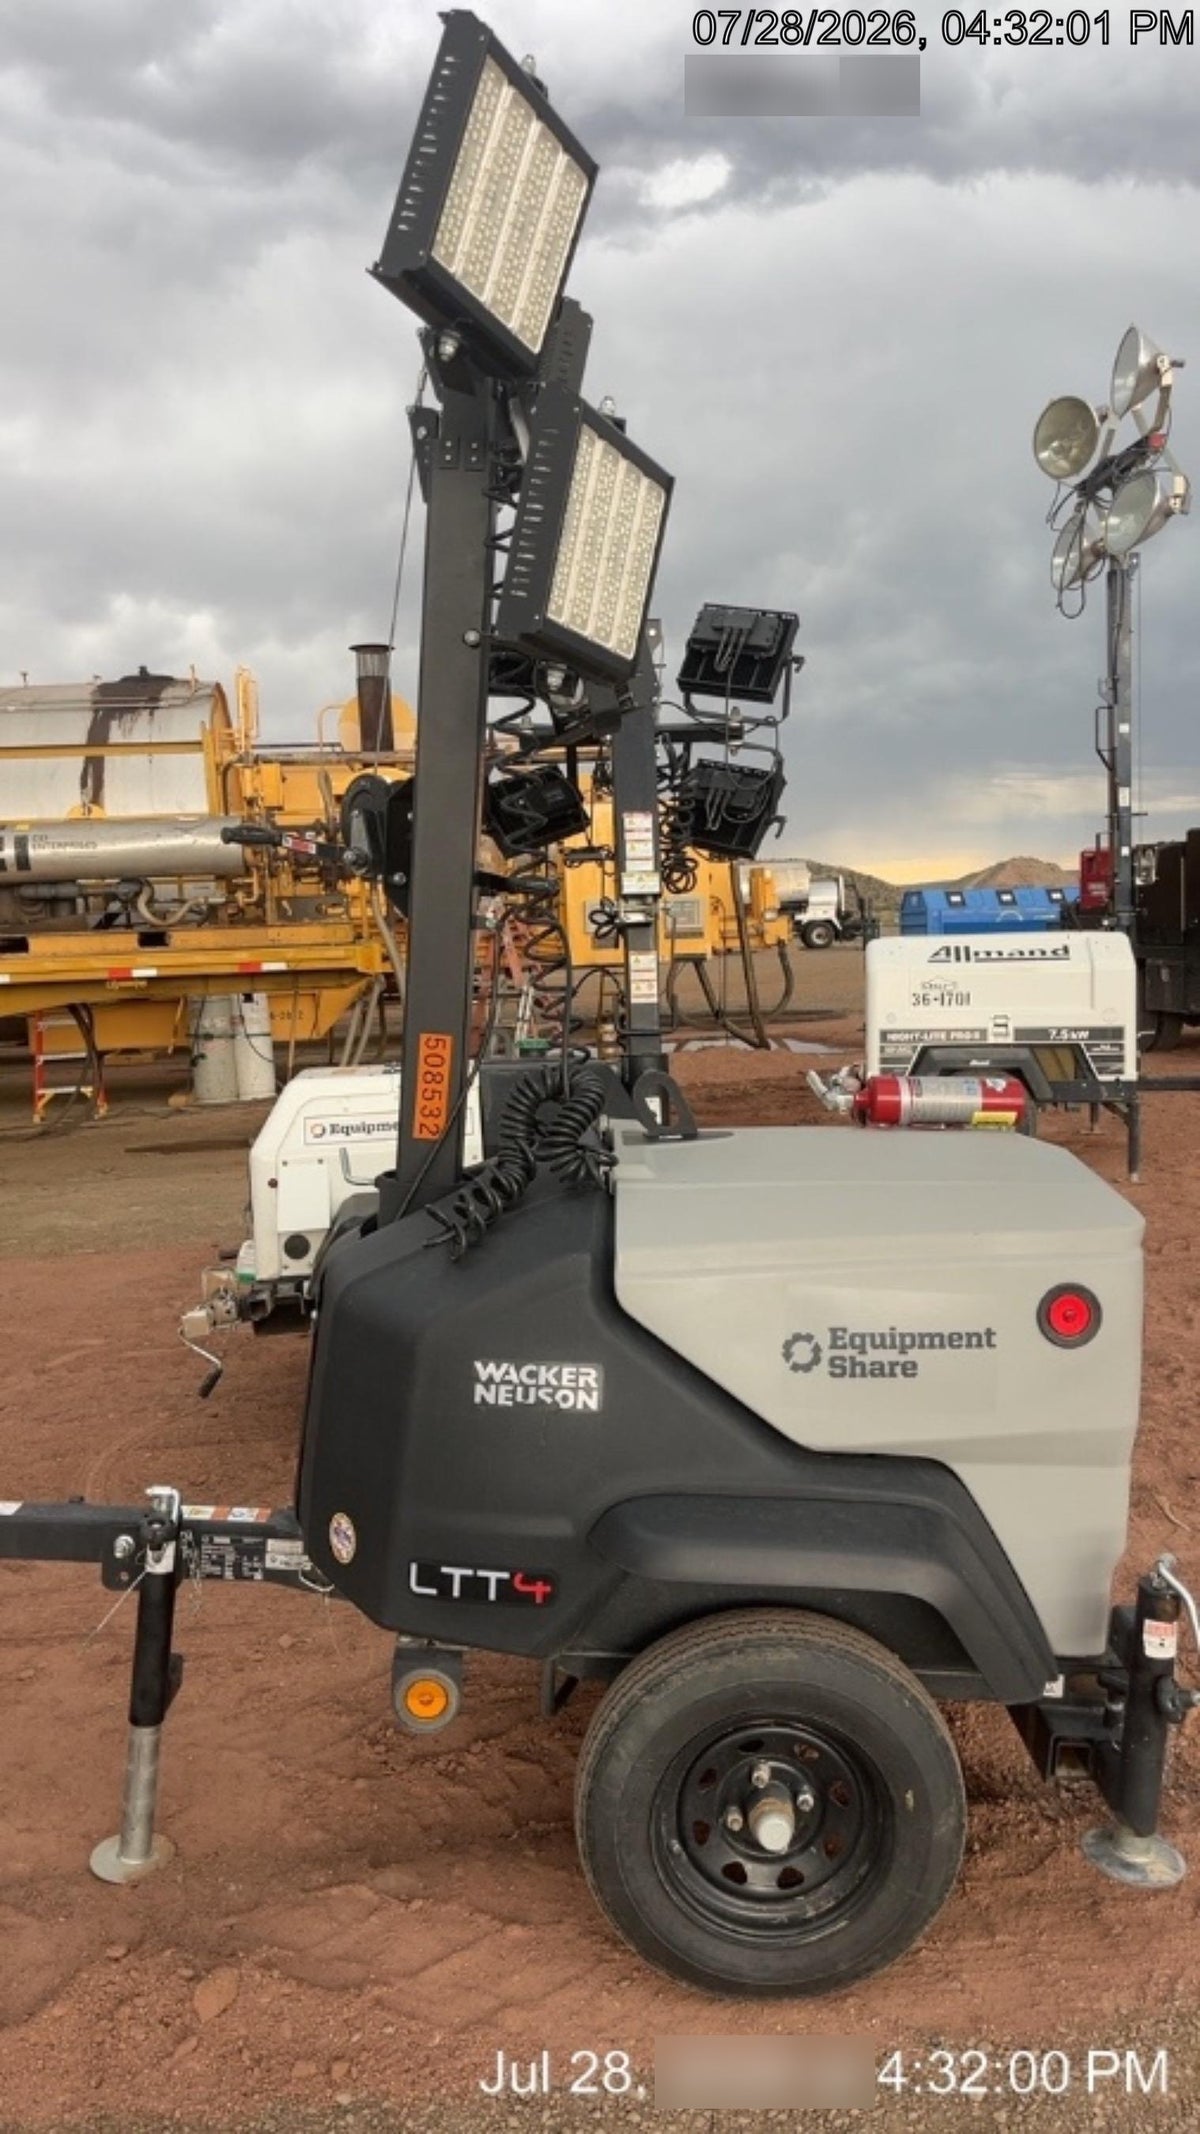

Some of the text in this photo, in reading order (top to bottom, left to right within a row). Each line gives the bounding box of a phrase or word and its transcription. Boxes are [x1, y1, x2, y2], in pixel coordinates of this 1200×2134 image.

[928, 944, 1070, 963] Allmand
[419, 1035, 447, 1137] 508532
[329, 1119, 399, 1137] Equipme
[828, 1327, 997, 1355] Equipment
[473, 1360, 599, 1388] WACKER
[828, 1355, 918, 1378] Share
[473, 1383, 599, 1412] NEUSON
[409, 1562, 552, 1604] LTT4
